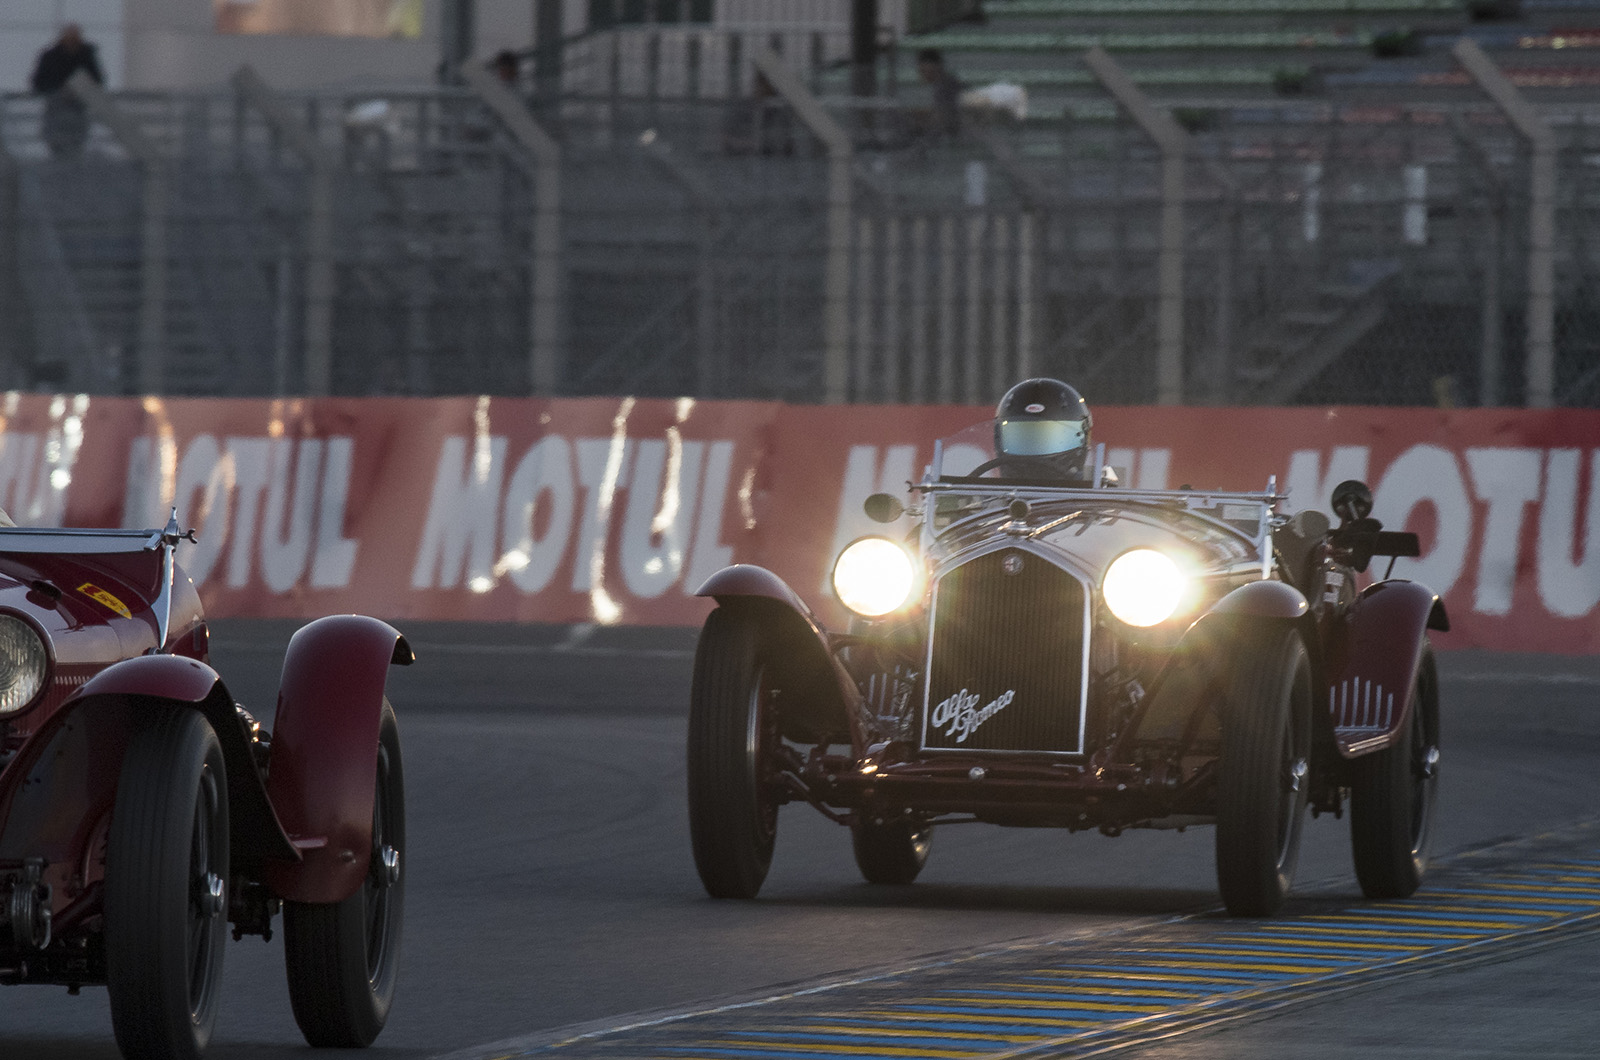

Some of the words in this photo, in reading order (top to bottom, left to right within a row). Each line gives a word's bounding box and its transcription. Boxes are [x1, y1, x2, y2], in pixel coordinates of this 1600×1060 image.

[410, 433, 735, 599] MOTUL
[931, 688, 980, 736] Alfa
[955, 689, 1016, 743] Romeo
